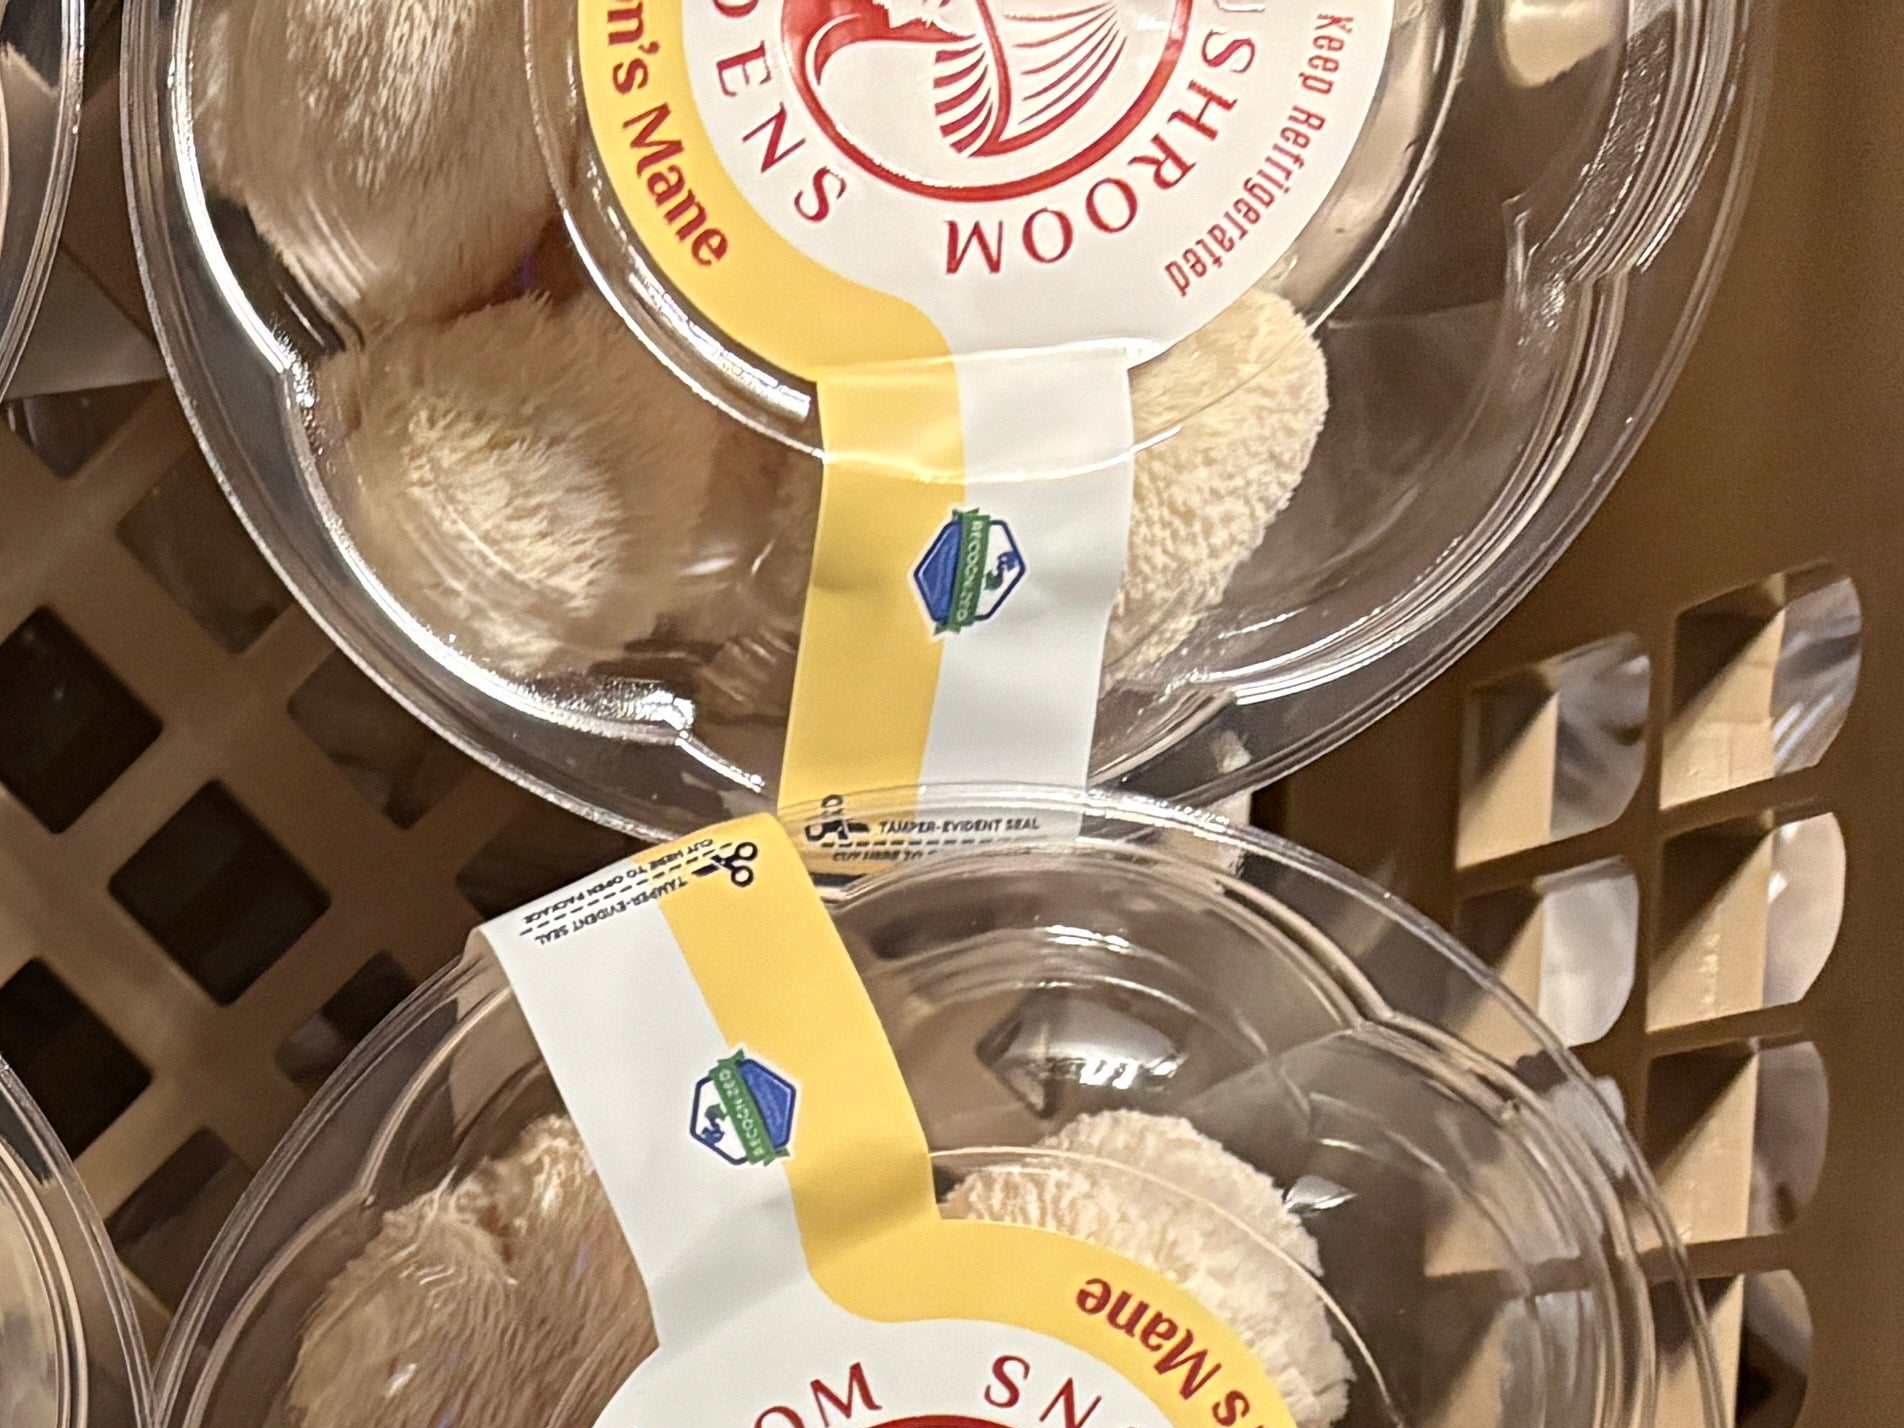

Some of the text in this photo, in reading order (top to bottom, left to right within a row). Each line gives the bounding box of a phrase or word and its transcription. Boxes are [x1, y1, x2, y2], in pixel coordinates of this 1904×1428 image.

[624, 104, 730, 267] Mane
[947, 0, 1257, 274] SHROOM
[1165, 15, 1353, 296] Keep Refrigerated
[572, 876, 688, 932] TAMPER-EVIDENT
[1073, 1276, 1221, 1399] Mane
